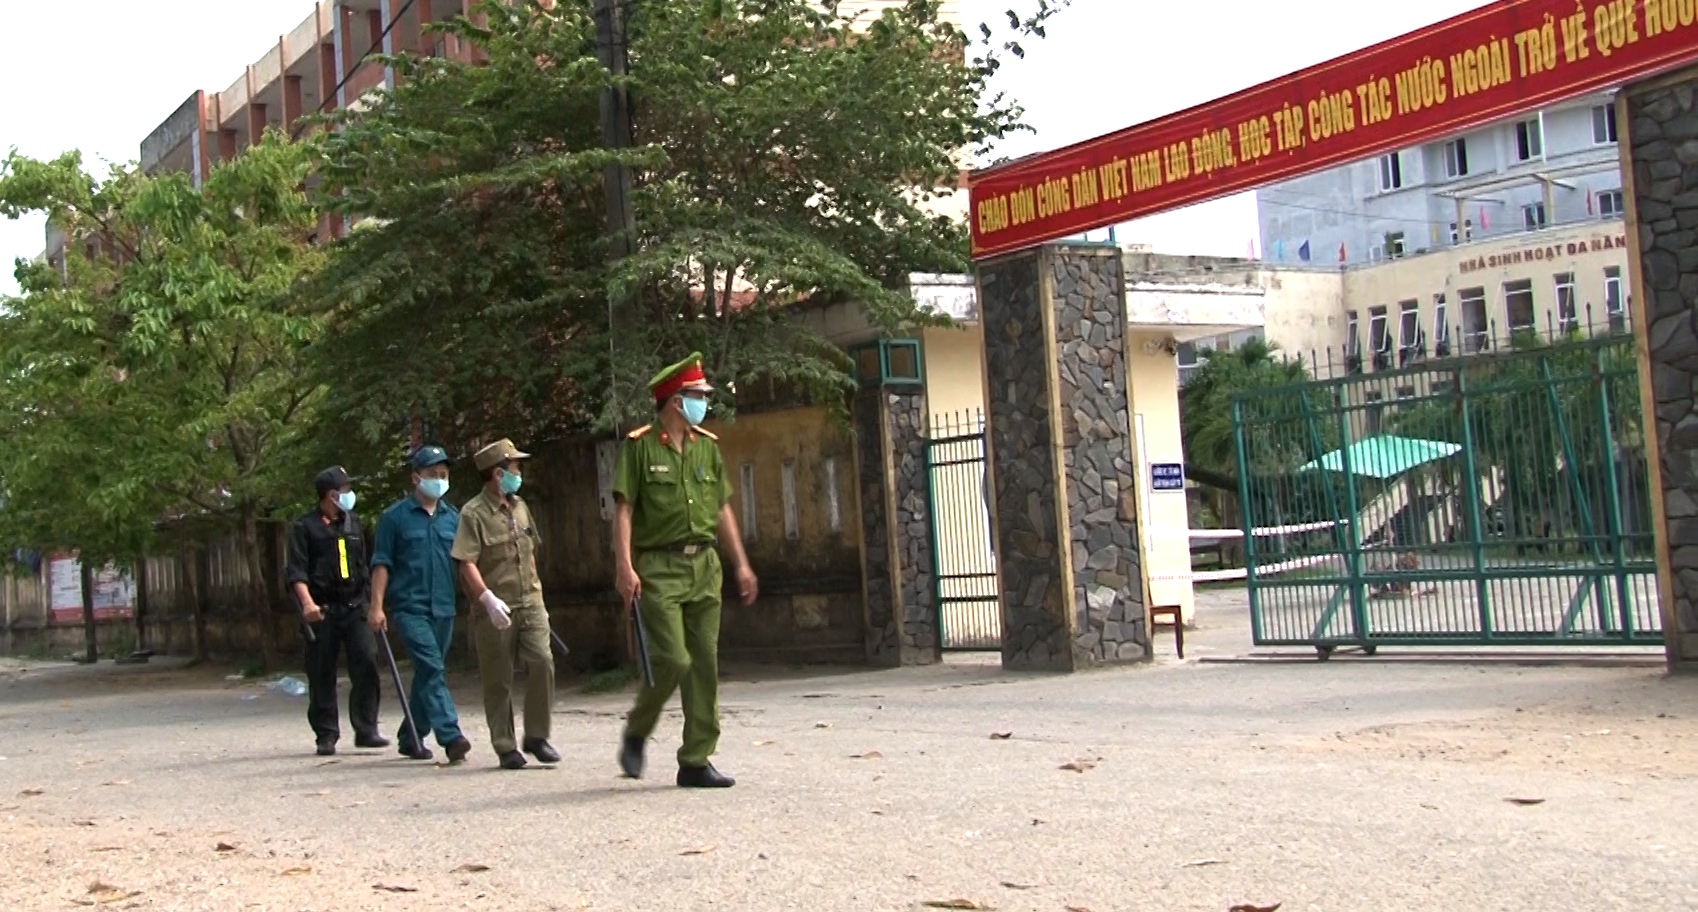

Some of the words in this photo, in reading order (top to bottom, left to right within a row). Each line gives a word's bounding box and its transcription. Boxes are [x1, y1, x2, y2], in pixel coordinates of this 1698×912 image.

[1037, 175, 1071, 219] CÔNG
[1072, 165, 1099, 209] DÂN
[1099, 156, 1128, 203] VIỆT
[1130, 149, 1162, 192] NAM
[1164, 140, 1190, 183] LAO
[1238, 115, 1272, 165] HỌC
[1308, 89, 1355, 142] CÔNG
[1356, 74, 1392, 126] TÁC
[1395, 55, 1447, 115] NƯỚC
[1449, 34, 1511, 98] NGOÀI
[1514, 12, 1557, 78] TRỞ
[1488, 250, 1521, 268] SINH
